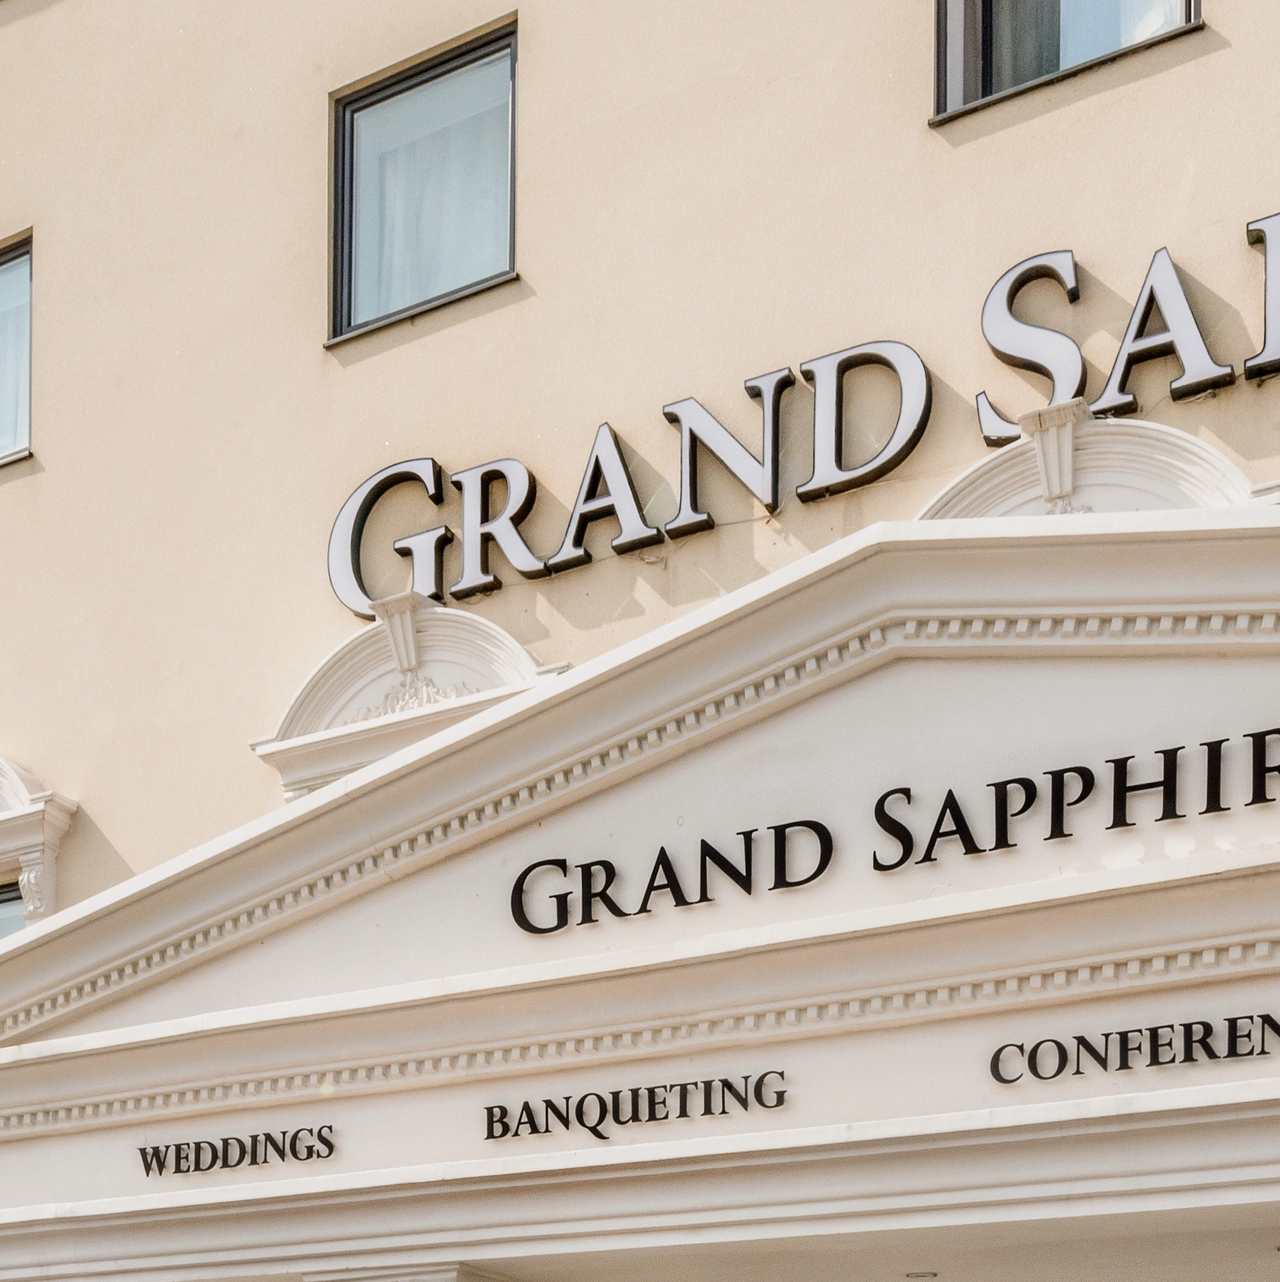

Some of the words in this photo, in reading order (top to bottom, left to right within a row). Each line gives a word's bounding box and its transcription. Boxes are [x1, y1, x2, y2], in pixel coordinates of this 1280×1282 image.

[327, 340, 933, 620] GRAND
[510, 820, 834, 935] GRAND
[137, 1124, 335, 1178] WEDDINGS
[484, 1070, 787, 1141] BANQUETING
